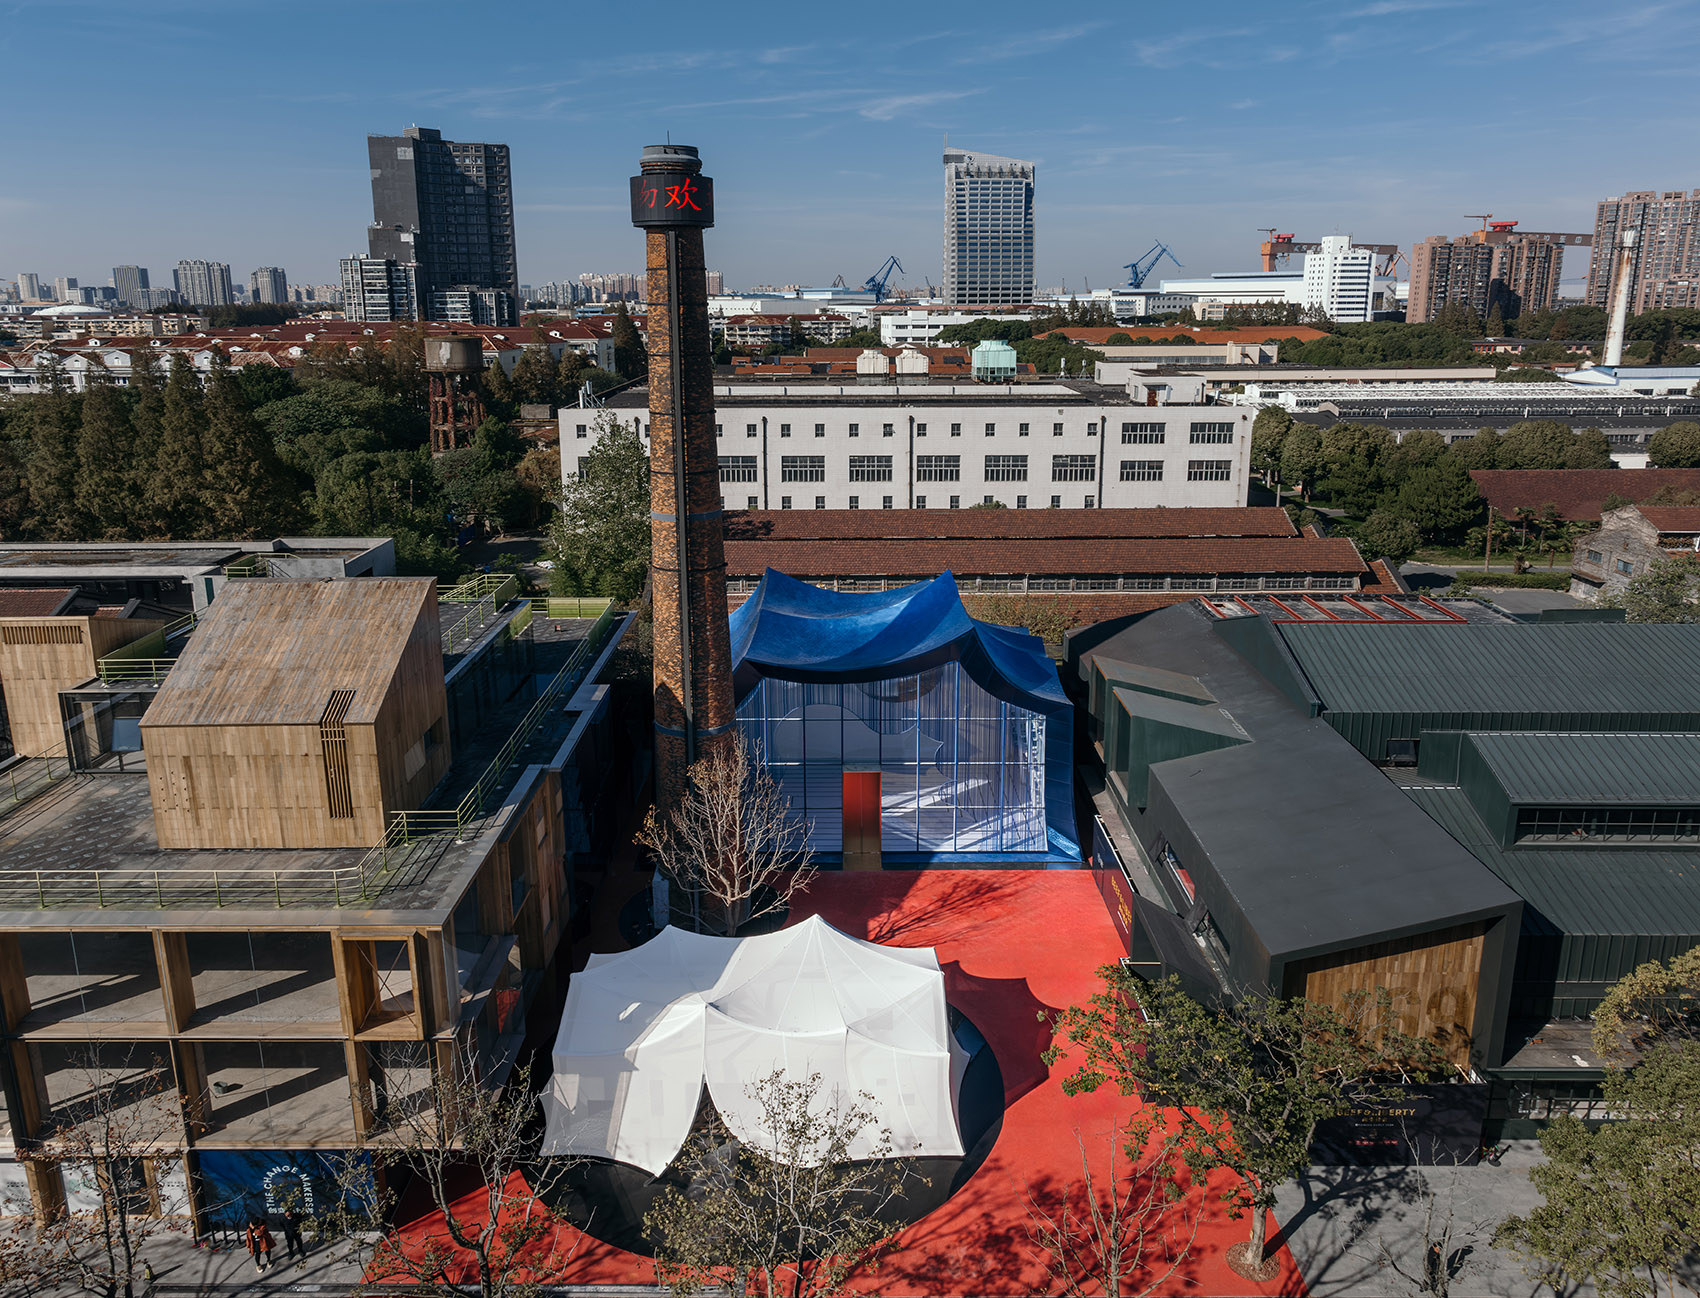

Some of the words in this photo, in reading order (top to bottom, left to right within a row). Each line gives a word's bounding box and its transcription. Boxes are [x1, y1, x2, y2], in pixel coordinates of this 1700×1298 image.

[263, 1165, 299, 1190] CHANGE
[264, 1192, 275, 1208] THE
[299, 1173, 314, 1208] MAKERS
